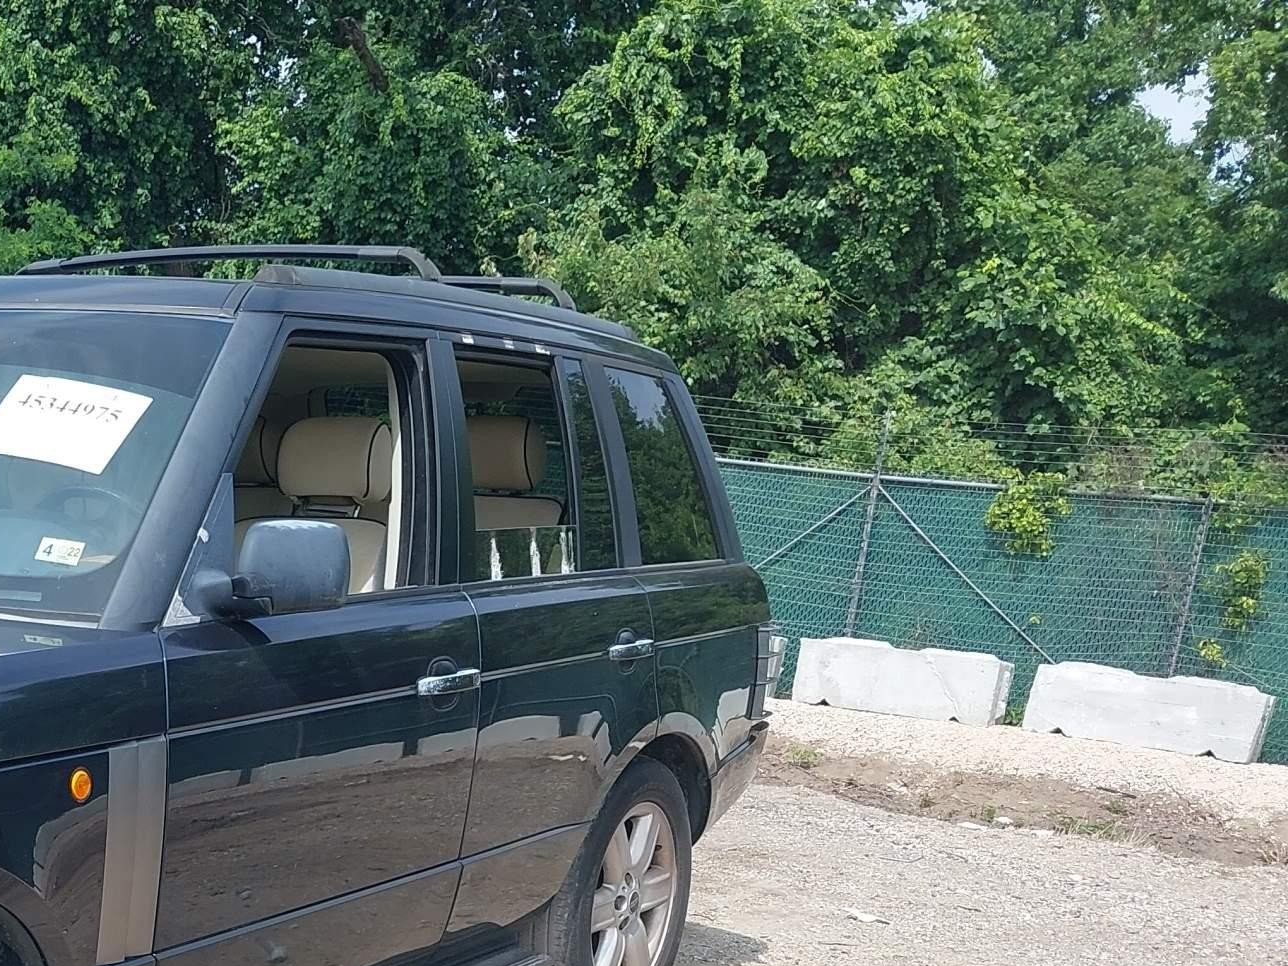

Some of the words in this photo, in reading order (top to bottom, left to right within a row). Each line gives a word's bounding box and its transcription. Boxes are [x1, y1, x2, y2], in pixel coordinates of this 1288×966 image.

[17, 392, 124, 424] 45344975
[42, 543, 54, 557] 4
[66, 546, 81, 558] 22
